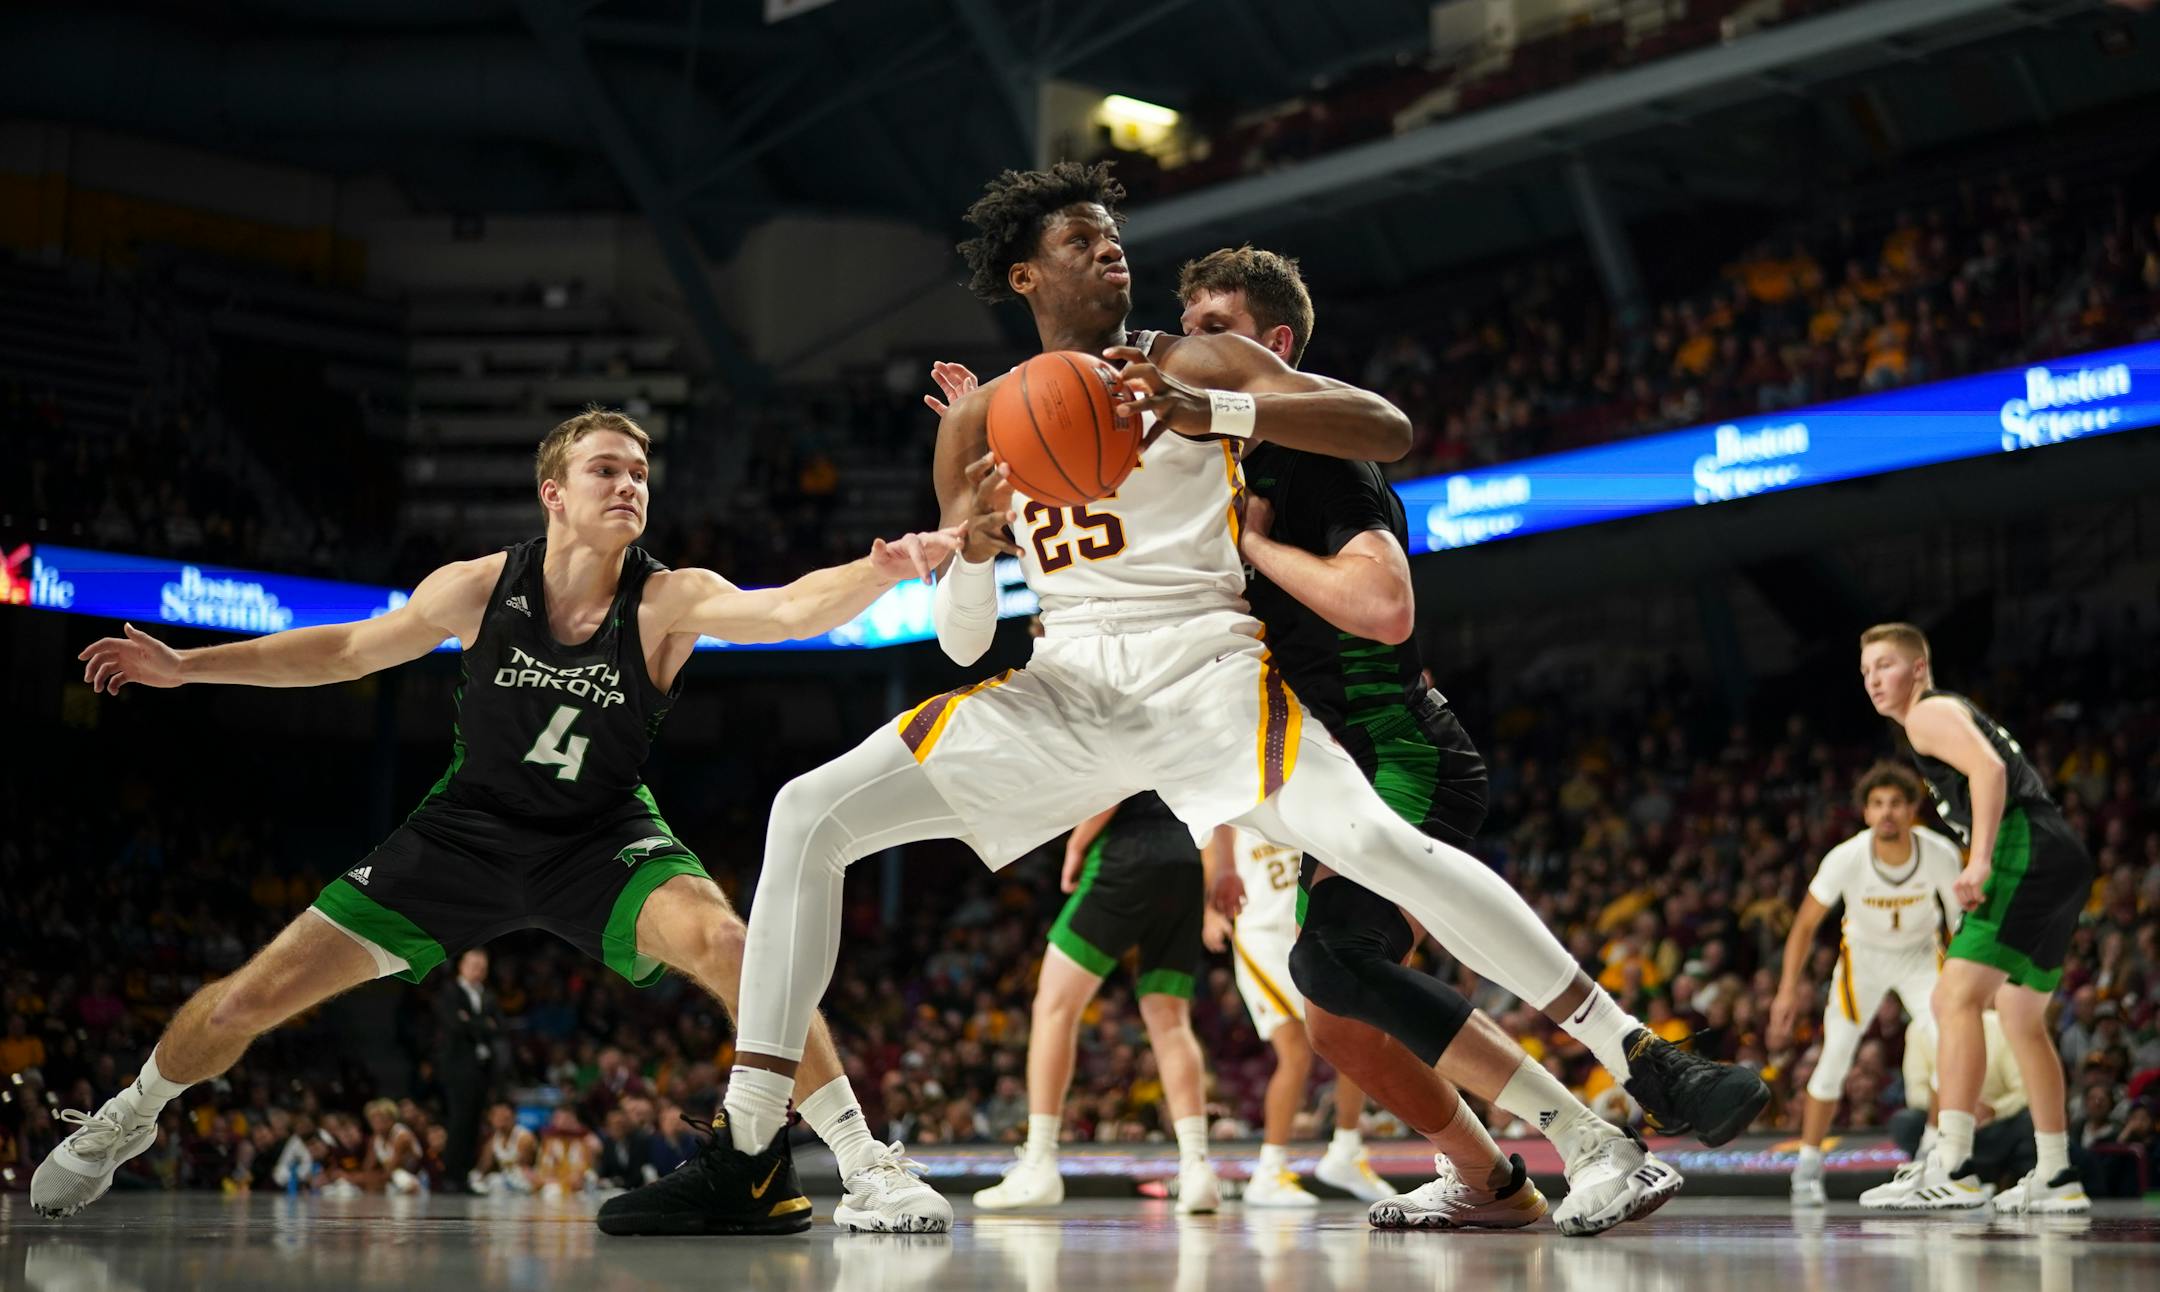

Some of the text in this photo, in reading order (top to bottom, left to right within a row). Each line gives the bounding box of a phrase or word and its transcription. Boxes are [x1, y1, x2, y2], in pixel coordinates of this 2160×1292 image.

[1023, 499, 1128, 576] 25
[494, 667, 626, 708] DAKOTA
[521, 704, 590, 782] 4
